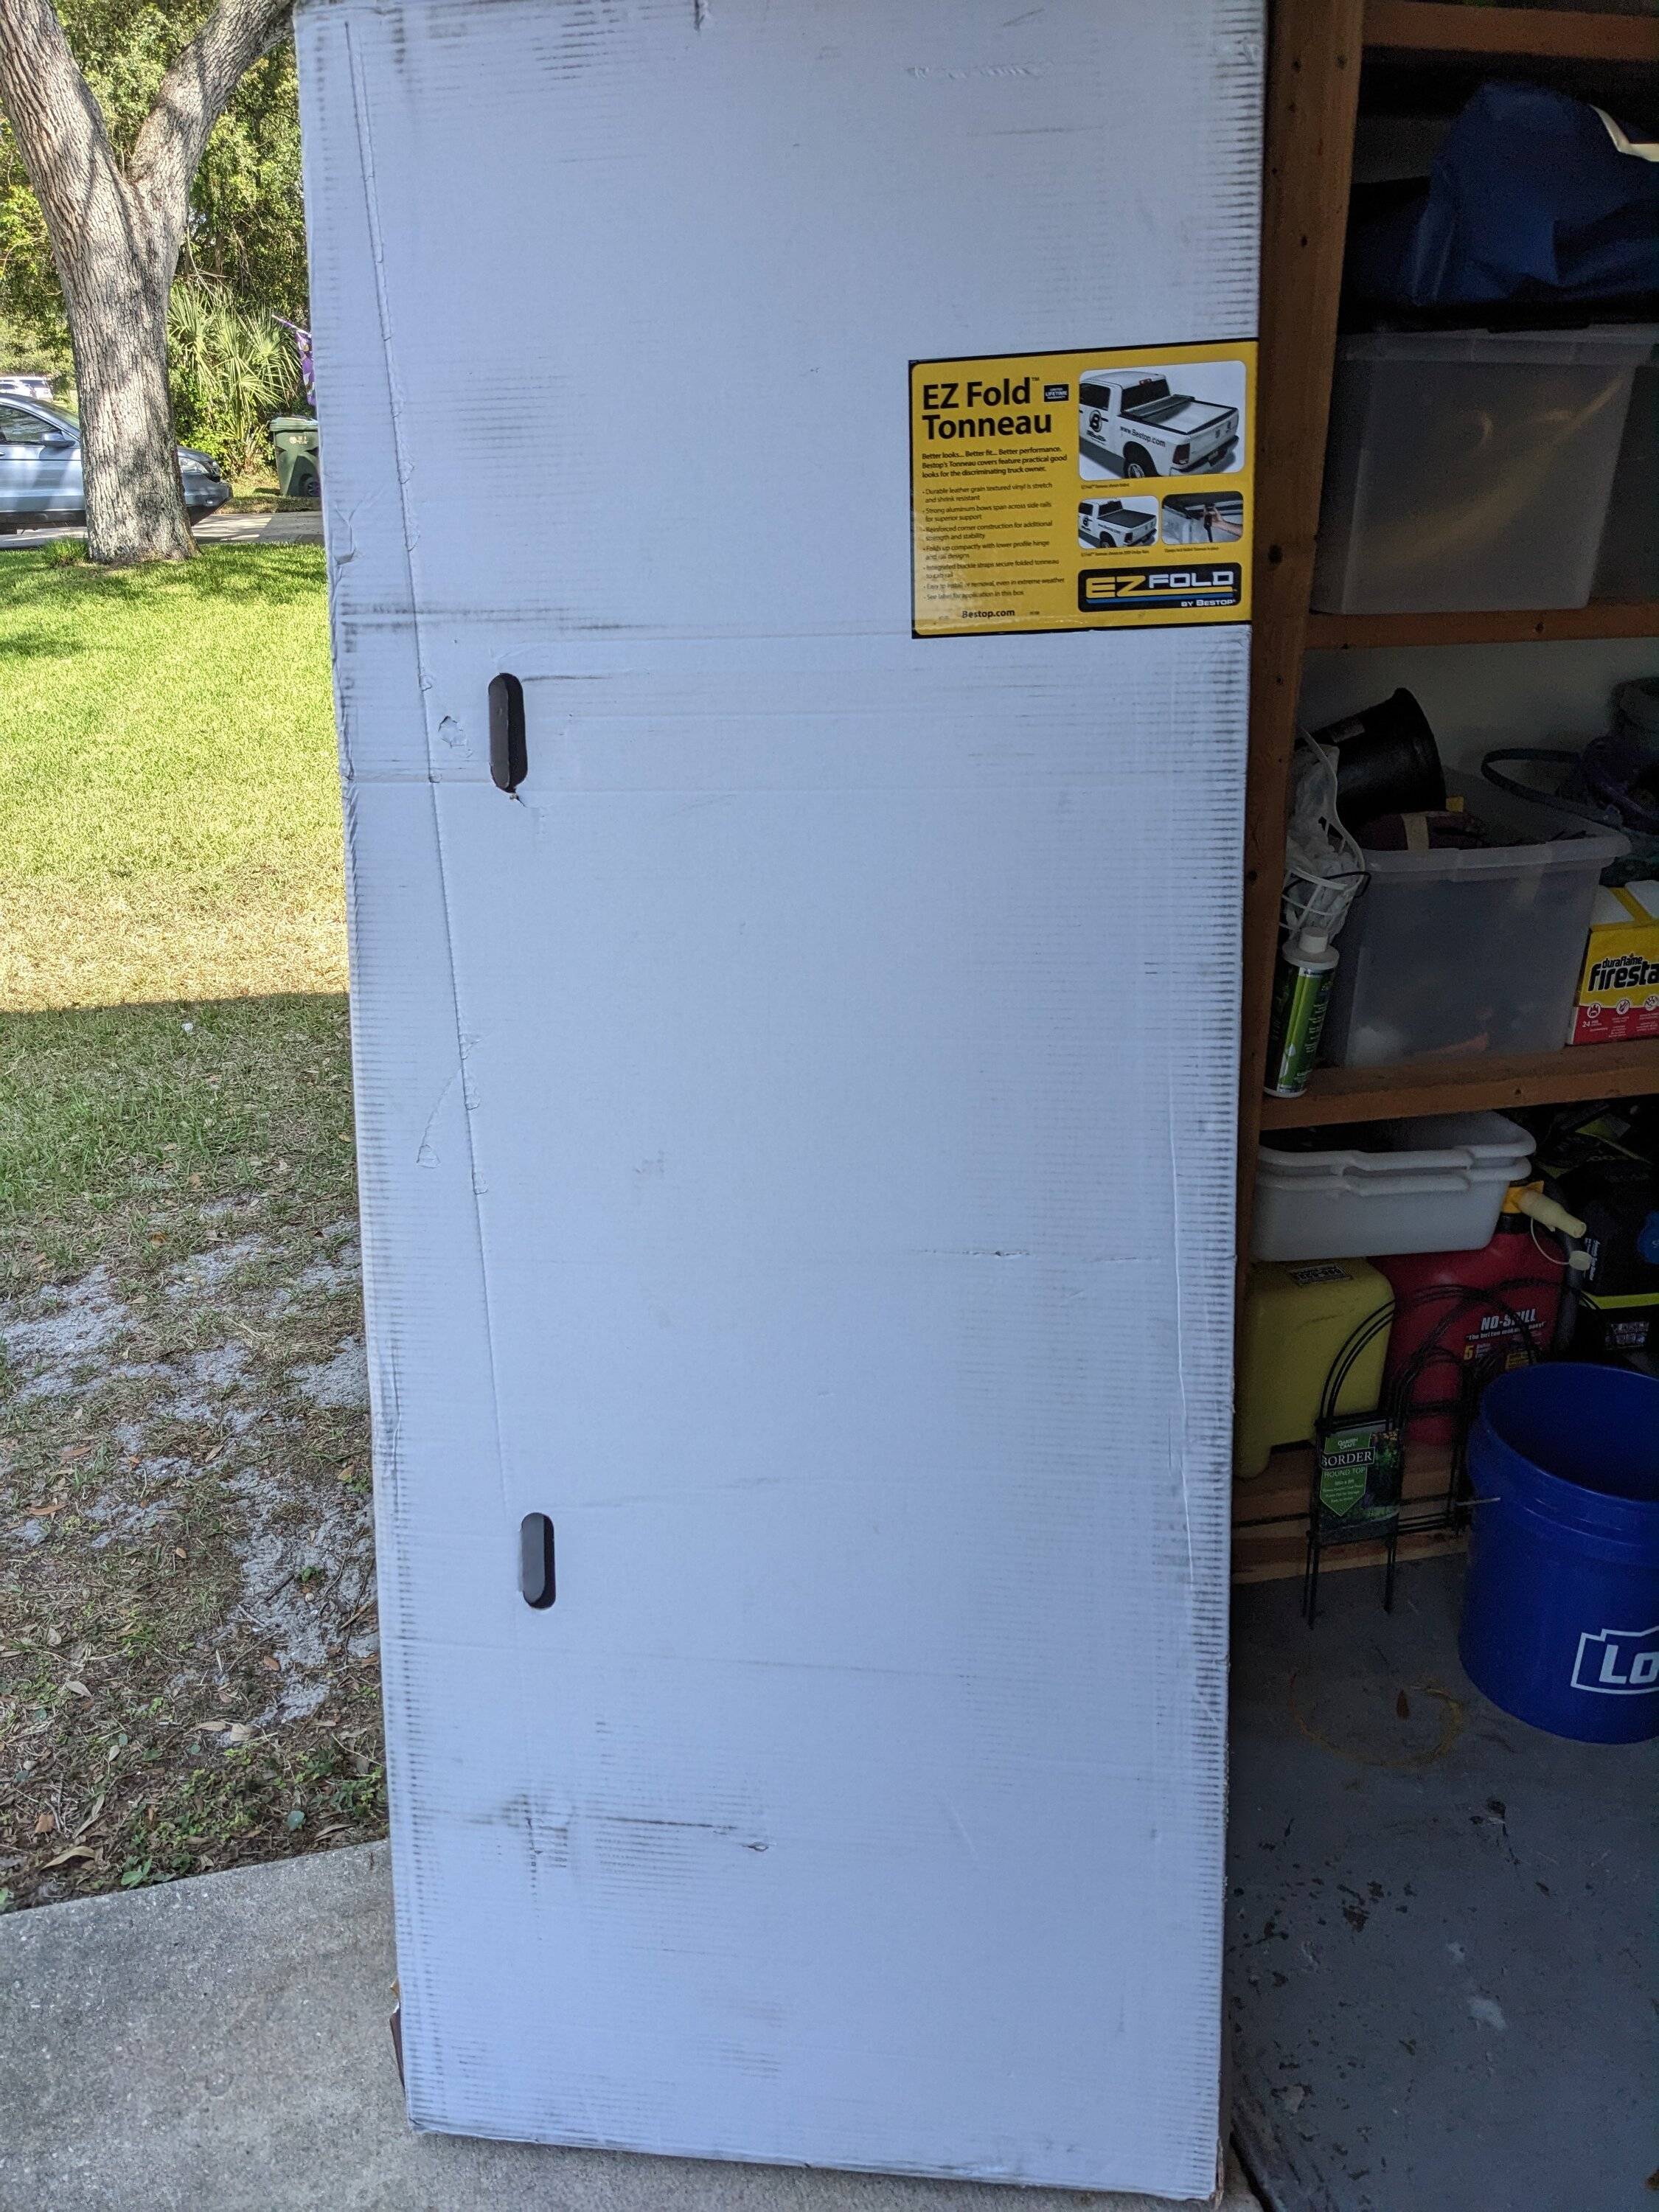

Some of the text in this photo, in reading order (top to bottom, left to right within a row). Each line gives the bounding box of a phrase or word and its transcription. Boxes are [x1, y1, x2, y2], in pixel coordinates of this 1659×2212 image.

[923, 383, 959, 410] EZ
[922, 414, 1052, 440] Tonneau
[1021, 456, 1049, 465] practical
[1049, 453, 1068, 463] good
[961, 467, 1006, 476] discriminating
[961, 609, 1015, 619] Bestop.com
[1602, 956, 1643, 969] duraflame
[1464, 1345, 1474, 1360] 5
[1321, 1451, 1371, 1467] BORDER
